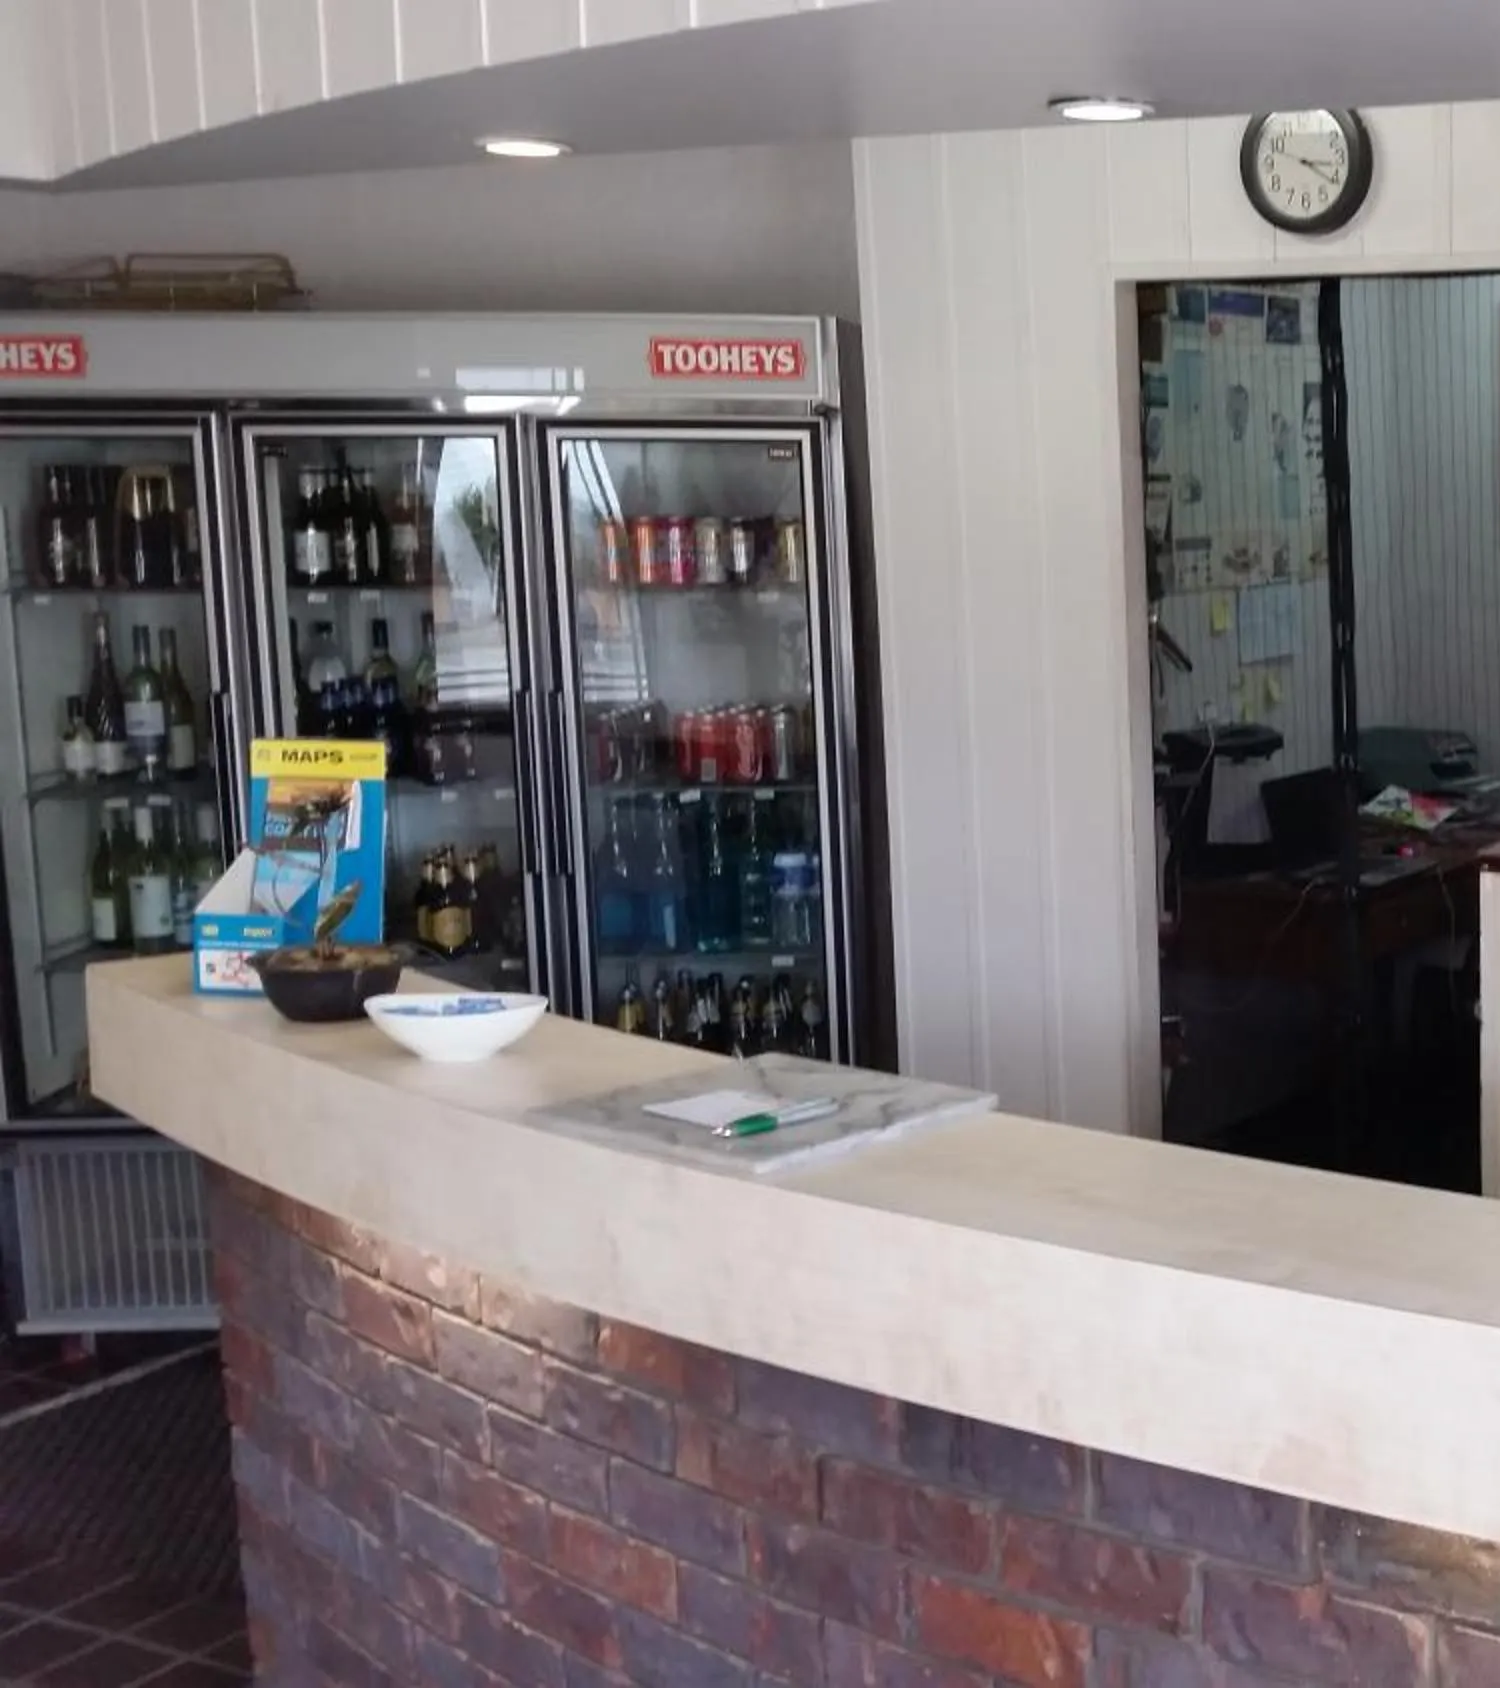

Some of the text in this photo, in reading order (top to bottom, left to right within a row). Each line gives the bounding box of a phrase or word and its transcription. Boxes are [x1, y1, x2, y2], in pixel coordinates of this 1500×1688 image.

[1271, 136, 1285, 154] 10
[1264, 154, 1275, 174] 9
[1301, 192, 1311, 209] 6
[0, 343, 77, 371] HEYS
[657, 343, 796, 374] TOOHEYS
[281, 748, 344, 764] MAPS
